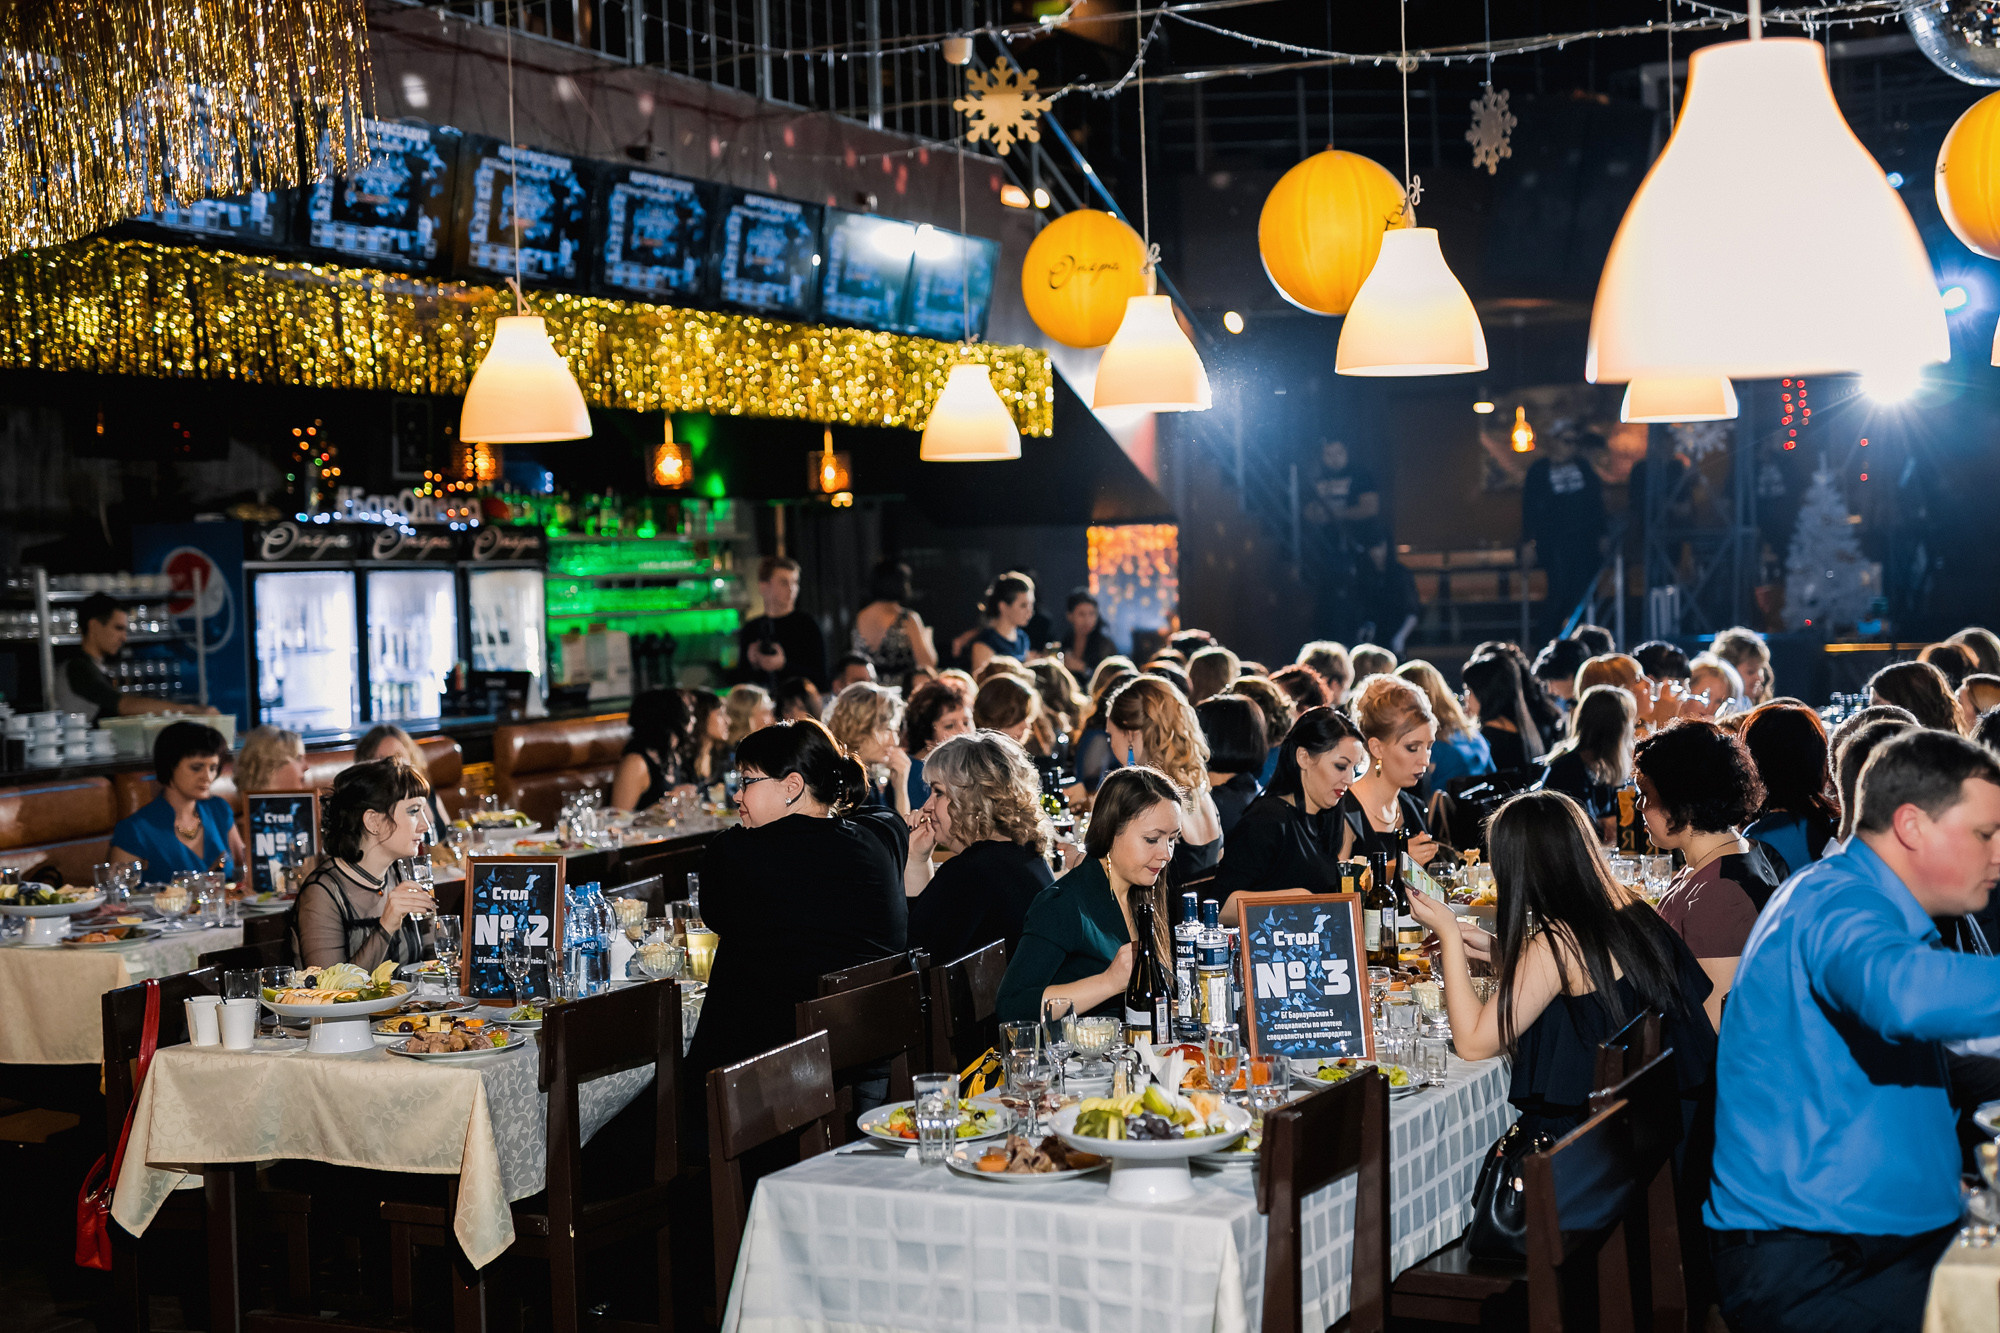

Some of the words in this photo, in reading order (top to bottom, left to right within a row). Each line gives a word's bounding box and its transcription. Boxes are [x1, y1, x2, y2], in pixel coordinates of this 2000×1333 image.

[264, 812, 294, 824] Стол
[492, 887, 529, 901] Стол
[523, 914, 549, 946] 2
[1273, 930, 1320, 947] Стол
[1321, 959, 1352, 996] 3
[1288, 1010, 1329, 1020] Барнаульская
[1330, 1008, 1334, 1017] 5
[1274, 1022, 1312, 1030] специалисты
[1266, 1032, 1304, 1041] специалисты
[1312, 1030, 1352, 1040] автокредитам
